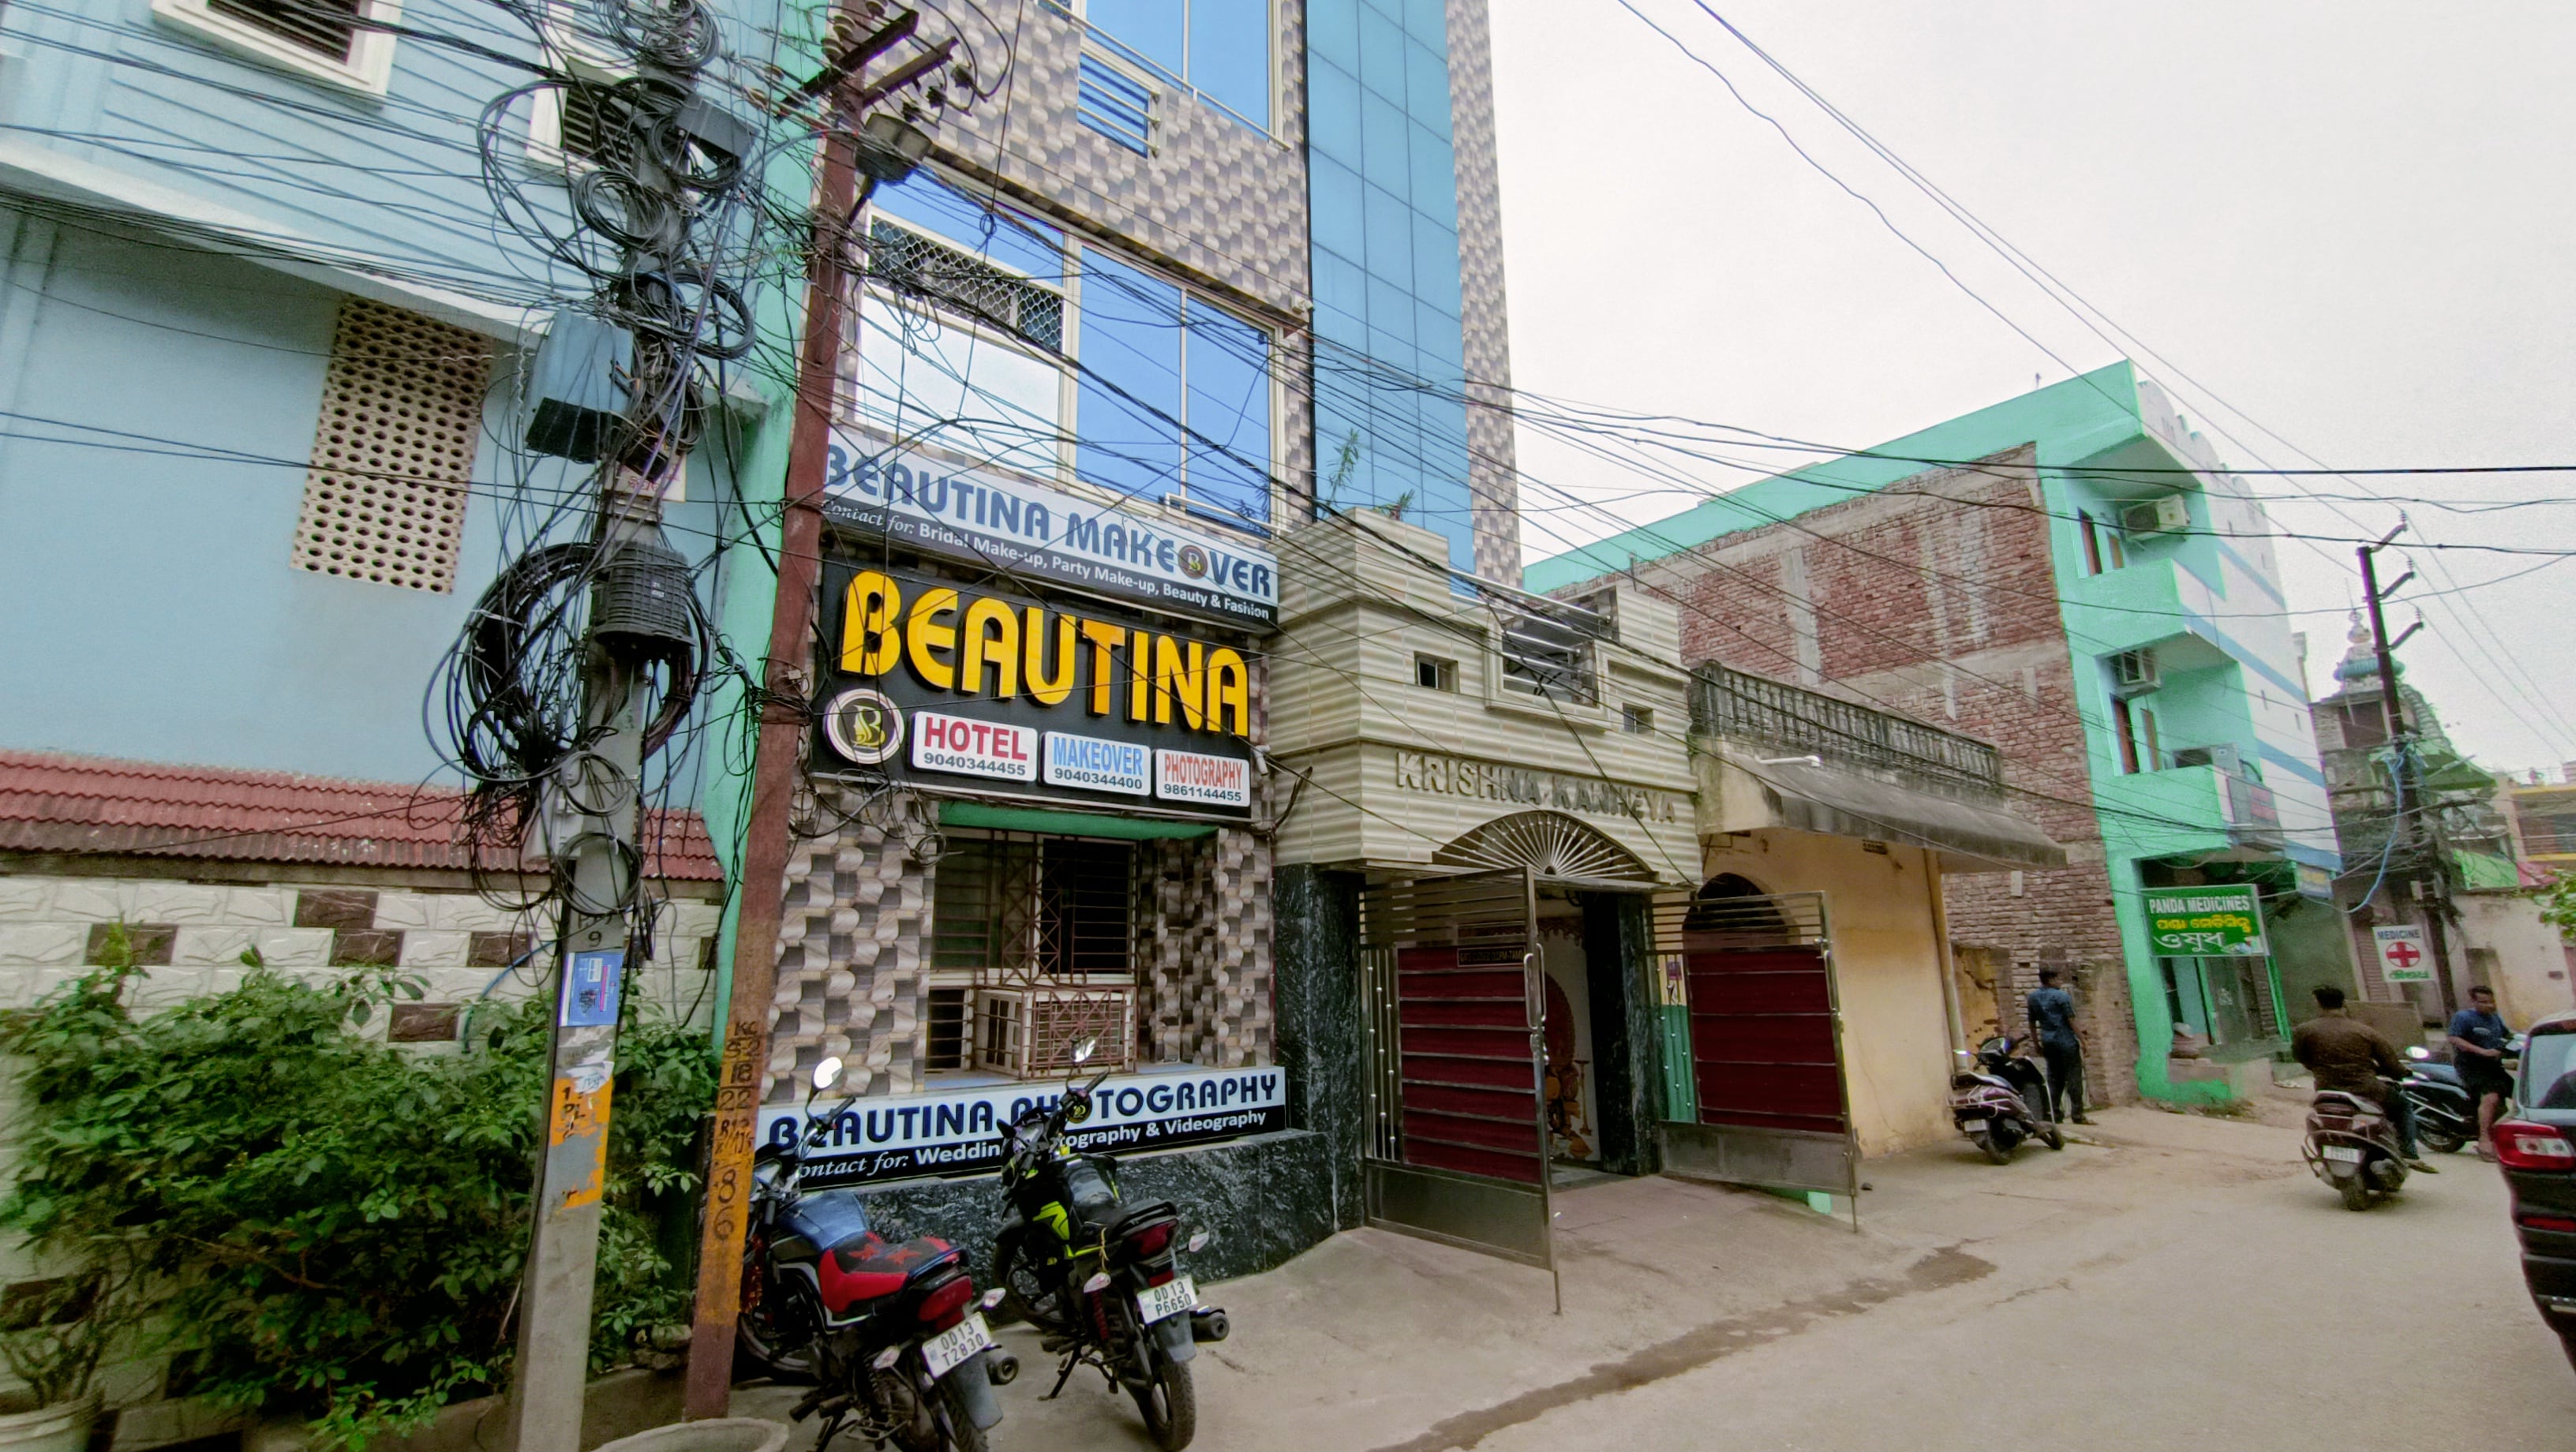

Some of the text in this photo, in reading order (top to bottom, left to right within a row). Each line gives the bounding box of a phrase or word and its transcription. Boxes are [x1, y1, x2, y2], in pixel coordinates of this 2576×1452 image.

[828, 444, 1050, 541] BEAUTINA
[882, 515, 913, 534] for:
[919, 523, 968, 547] Bridal
[974, 537, 1048, 569] Make-up,
[1053, 556, 1091, 579] Party
[1095, 567, 1159, 595] Make-up,
[1163, 583, 1208, 608] Beauty
[1211, 595, 1221, 608] &
[1224, 601, 1269, 619] Fashion
[838, 570, 1249, 736] BEAUTINA
[923, 717, 1028, 761] HOTEL
[1054, 738, 1144, 776] MAKEOVER
[924, 752, 1026, 777] 9040344455
[1054, 768, 1143, 791] 9040344400
[1165, 754, 1242, 791] PHOTOGRAPHY
[1396, 751, 1542, 805] KRISHNA
[1163, 783, 1242, 803] 9861144455
[2149, 896, 2250, 914] PANDA MEDICINES
[2377, 930, 2421, 940] MEDICINE
[798, 1157, 867, 1178] ontact
[867, 1151, 908, 1177] for:
[915, 1142, 1001, 1166] Weddin
[1146, 1121, 1161, 1137] &
[1165, 1110, 1267, 1136] Videography
[1155, 1293, 1193, 1316] P6650
[942, 1332, 984, 1366] T2830
